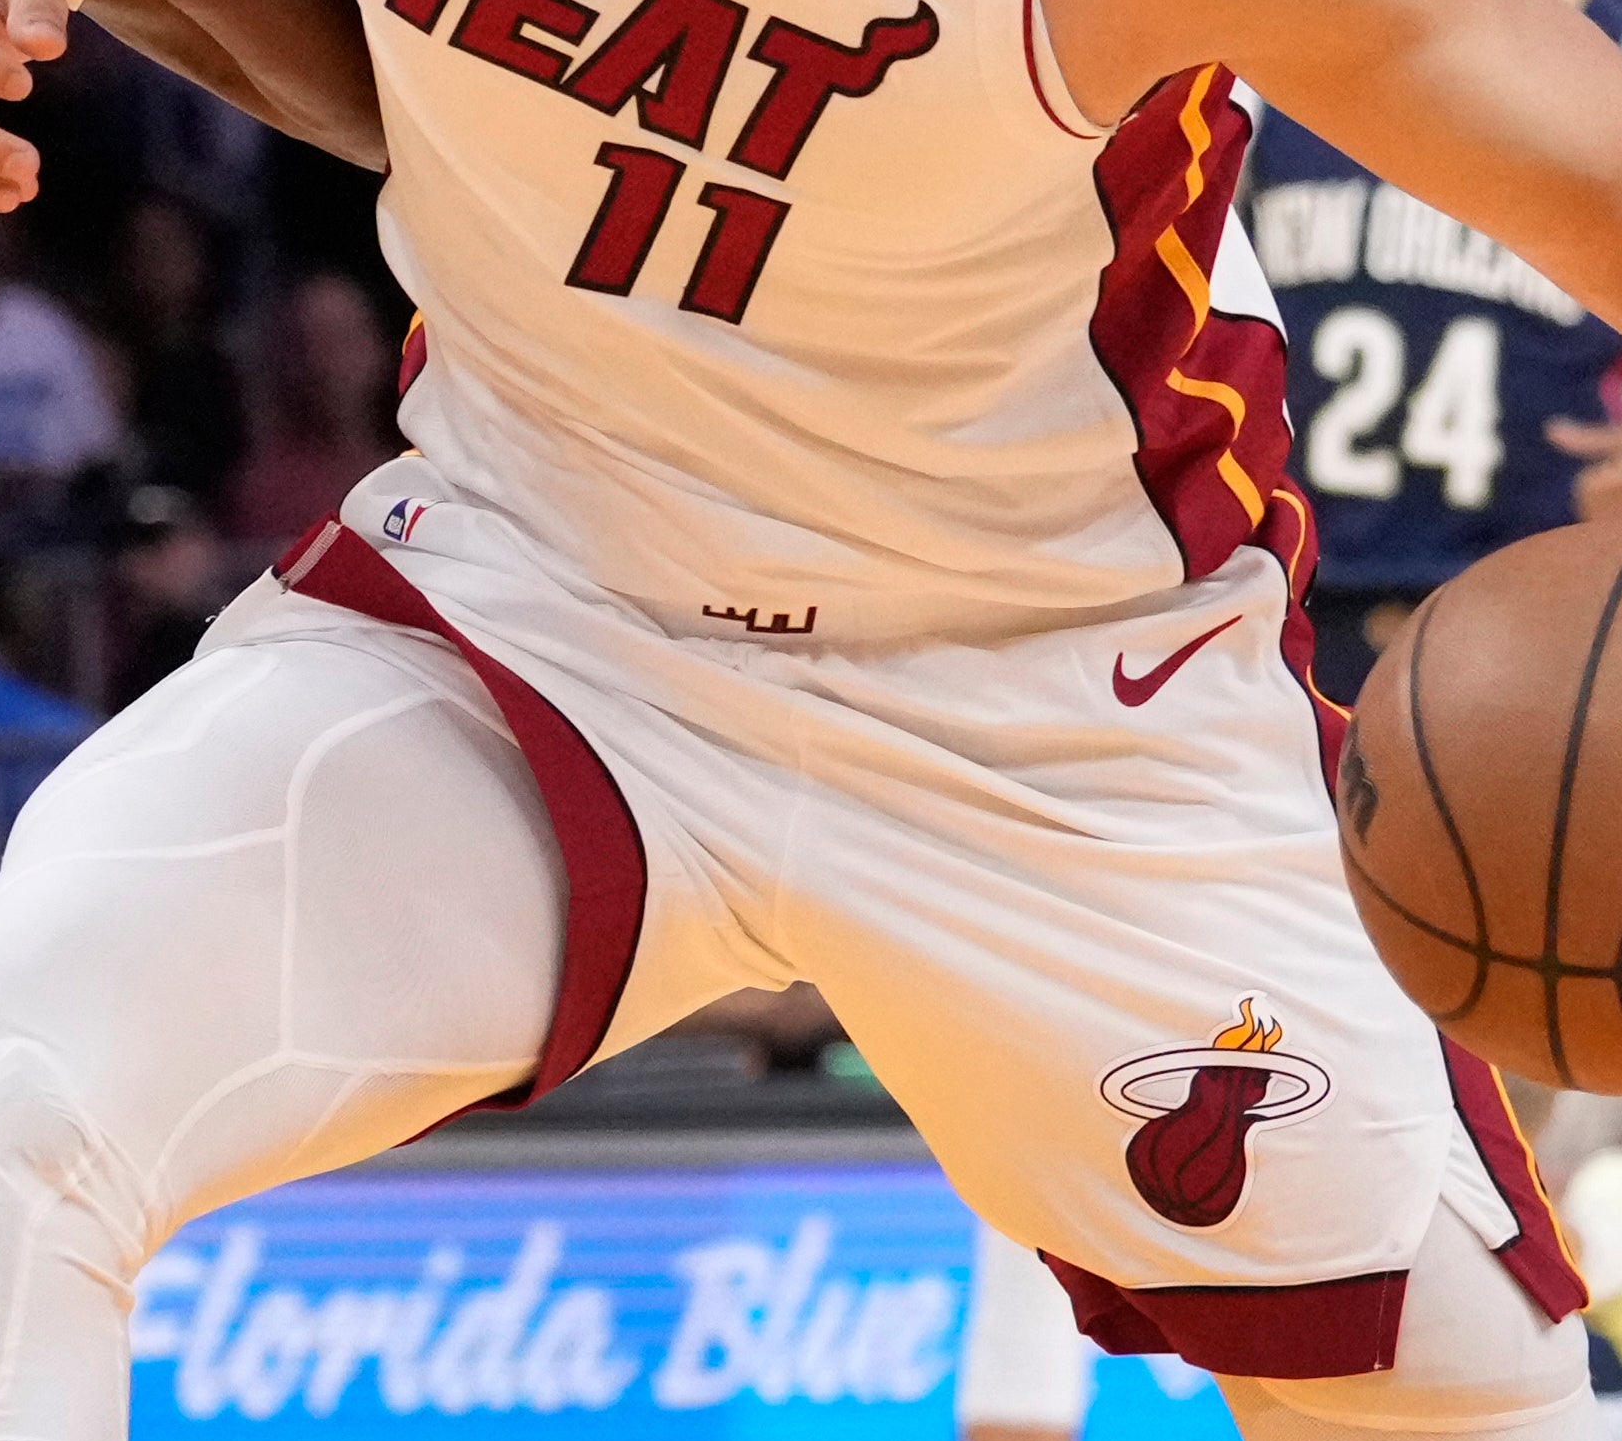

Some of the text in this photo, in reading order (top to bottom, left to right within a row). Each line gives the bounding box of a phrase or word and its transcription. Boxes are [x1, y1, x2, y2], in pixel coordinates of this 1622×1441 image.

[565, 141, 792, 325] 11
[1306, 303, 1506, 509] 24
[650, 1215, 954, 1409] Blue
